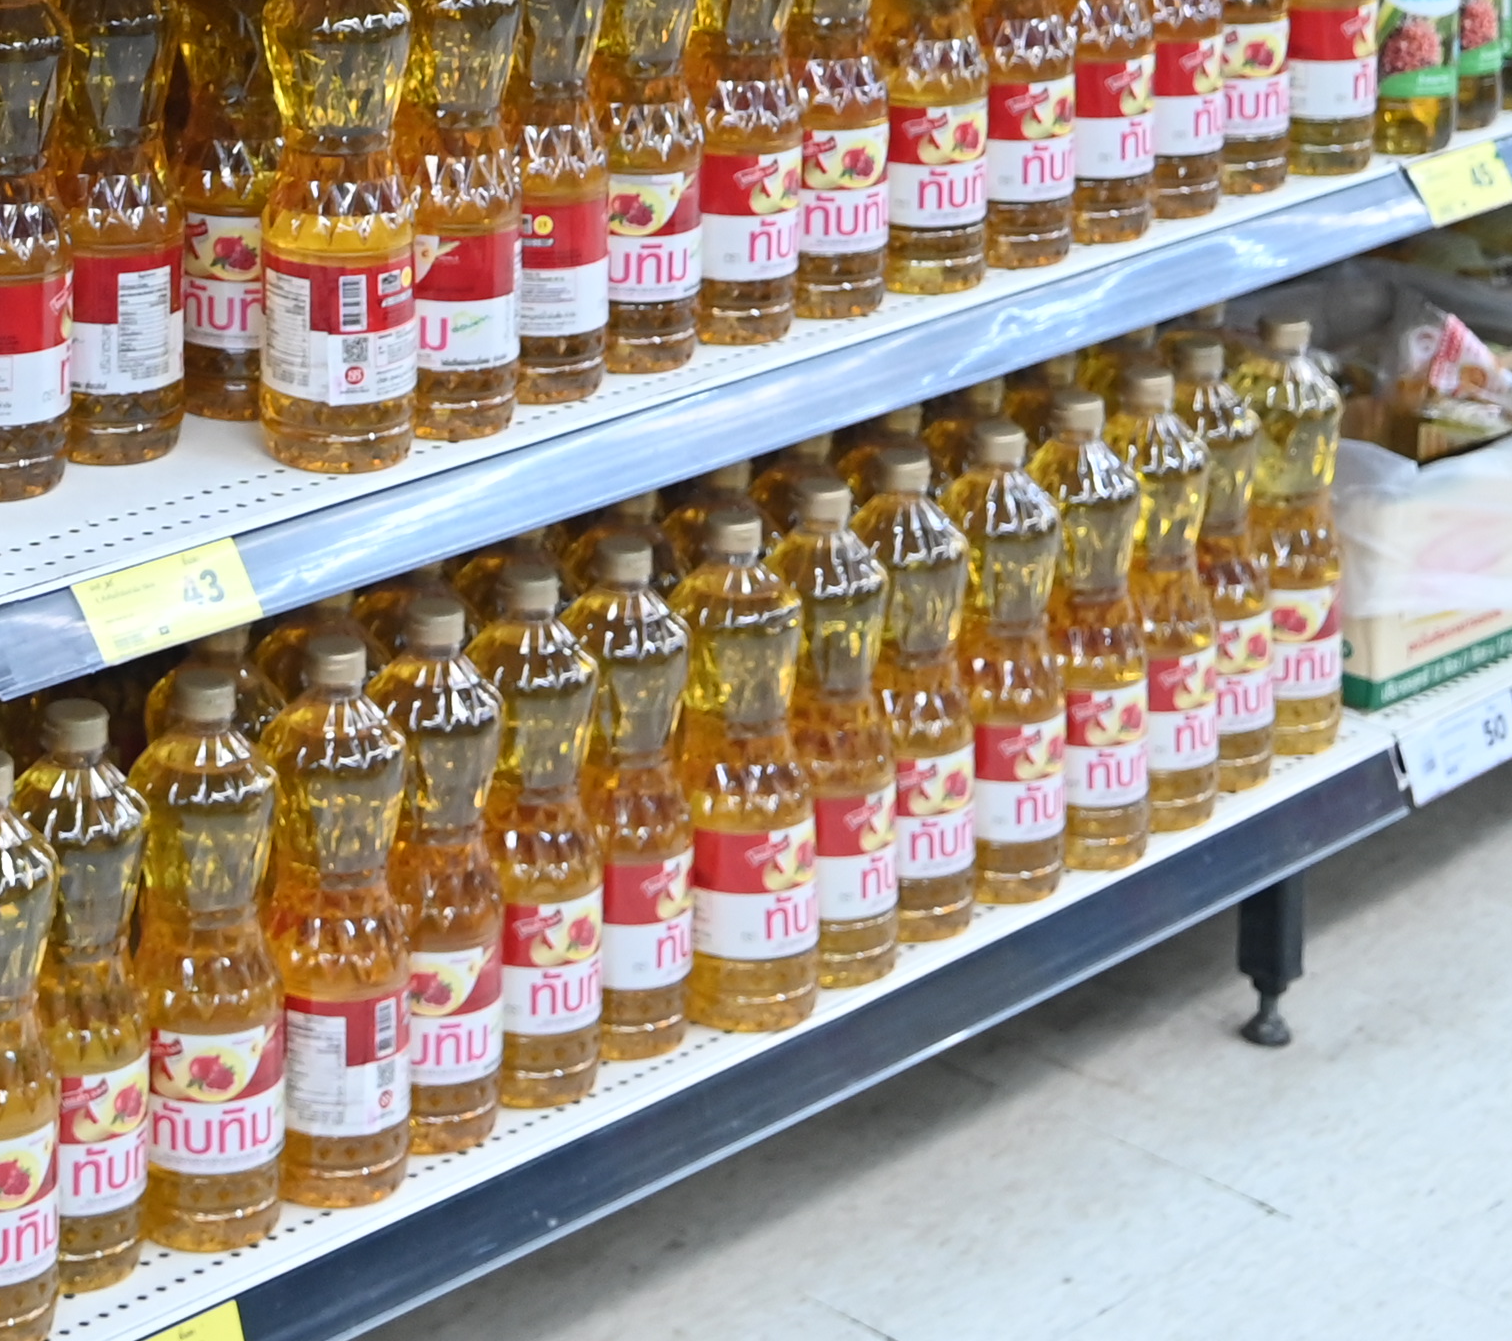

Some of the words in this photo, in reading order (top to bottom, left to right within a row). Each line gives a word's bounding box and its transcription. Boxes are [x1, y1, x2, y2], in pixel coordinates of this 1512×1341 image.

[183, 568, 225, 605] 43
[1482, 714, 1509, 748] 50
[154, 1105, 271, 1155] ทับทิม
